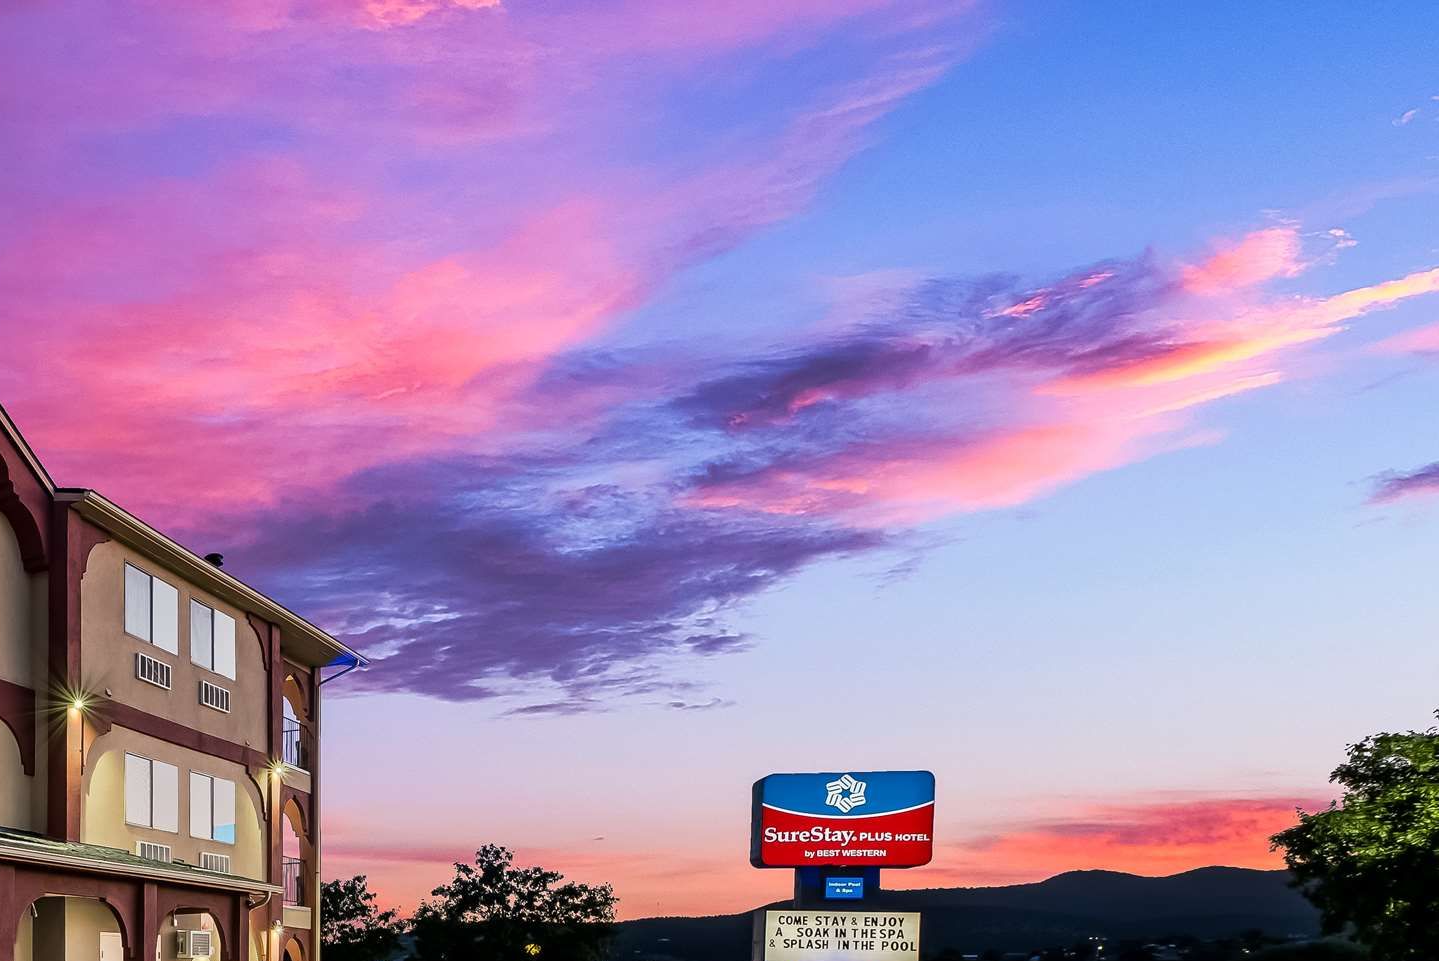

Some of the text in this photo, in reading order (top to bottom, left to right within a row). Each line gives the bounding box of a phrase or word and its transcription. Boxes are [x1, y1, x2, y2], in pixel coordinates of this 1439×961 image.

[859, 832, 893, 842] PLUS
[895, 833, 930, 842] HOTEL
[804, 849, 887, 859] by BEST WESTERN
[778, 915, 905, 927] COME STAY & ENJOY
[775, 927, 783, 937] A
[796, 927, 830, 938] SOAK
[835, 928, 847, 938] IN
[769, 938, 917, 952] & SPLASH IN THE POOL
